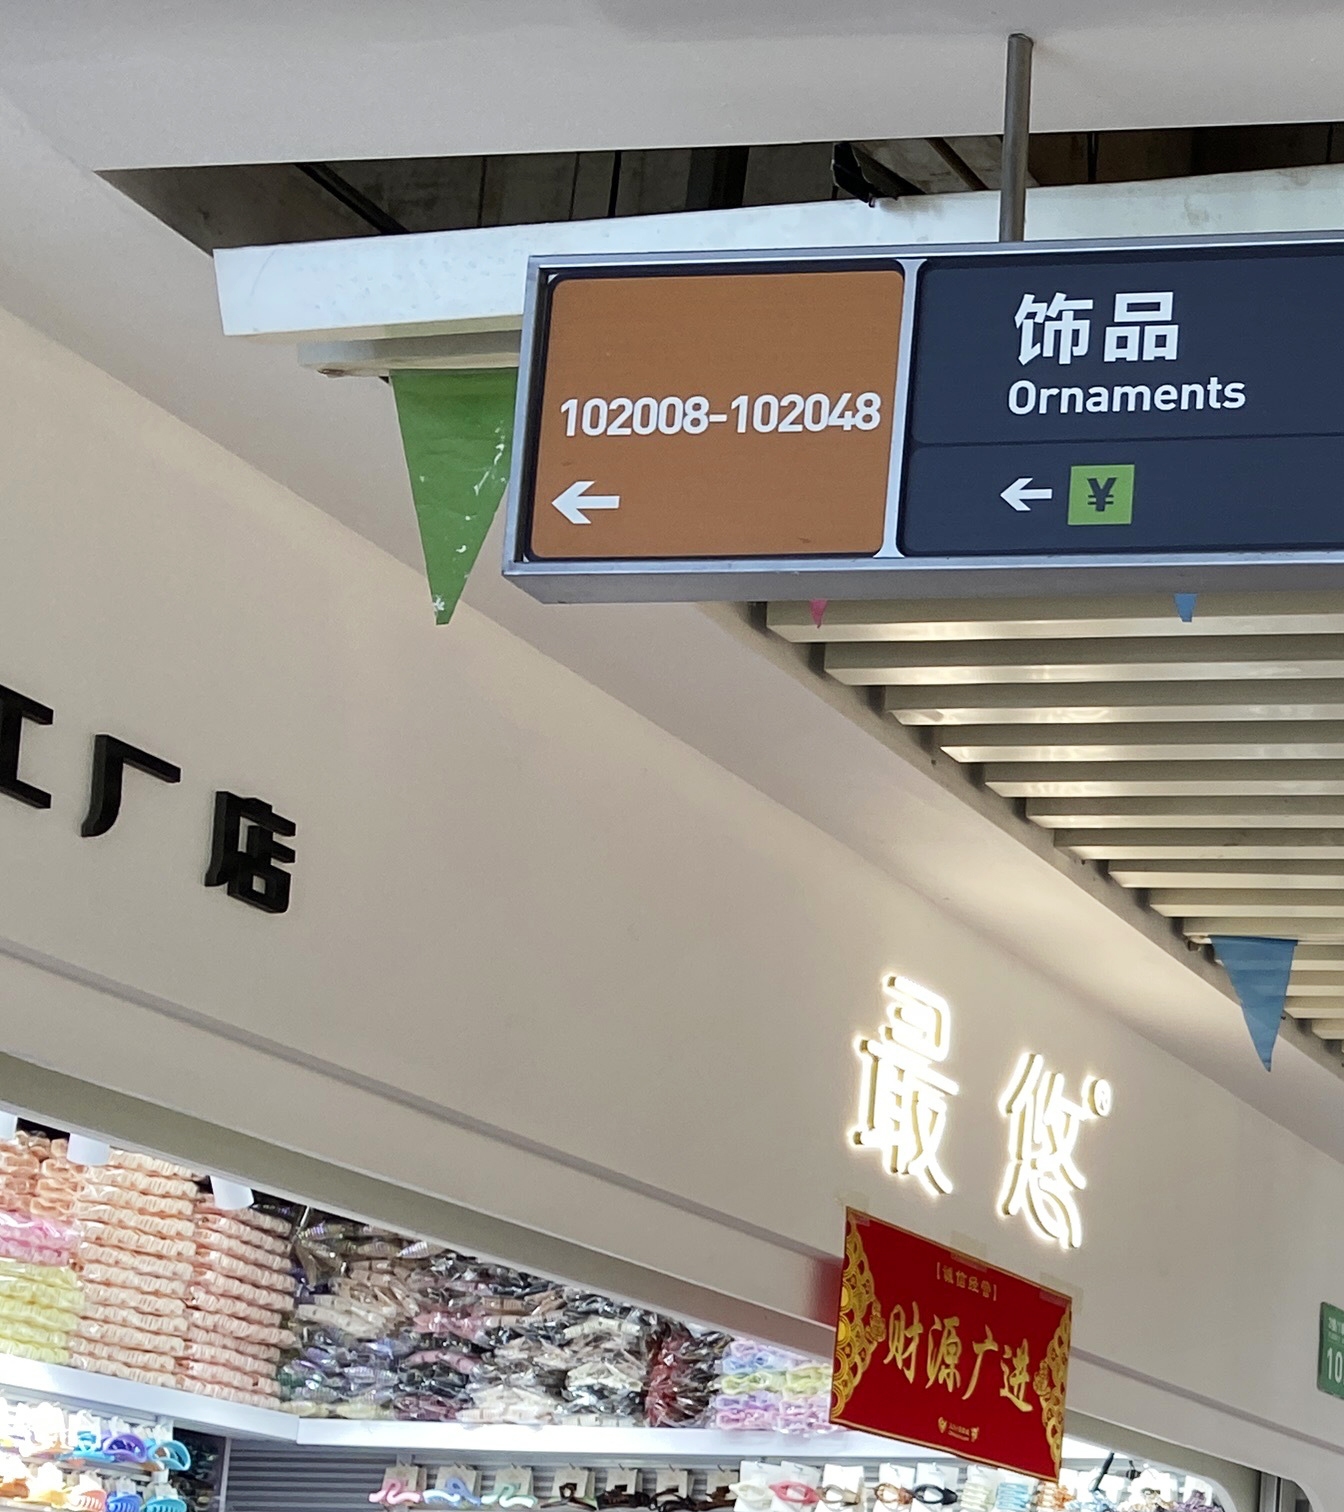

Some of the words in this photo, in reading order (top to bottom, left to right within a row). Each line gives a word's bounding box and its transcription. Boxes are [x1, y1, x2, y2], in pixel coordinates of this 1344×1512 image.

[1013, 291, 1180, 366] 饰品
[559, 391, 883, 437] 102008-102048
[1006, 374, 1247, 416] Ornaments
[883, 1301, 1034, 1413] 财源广进
